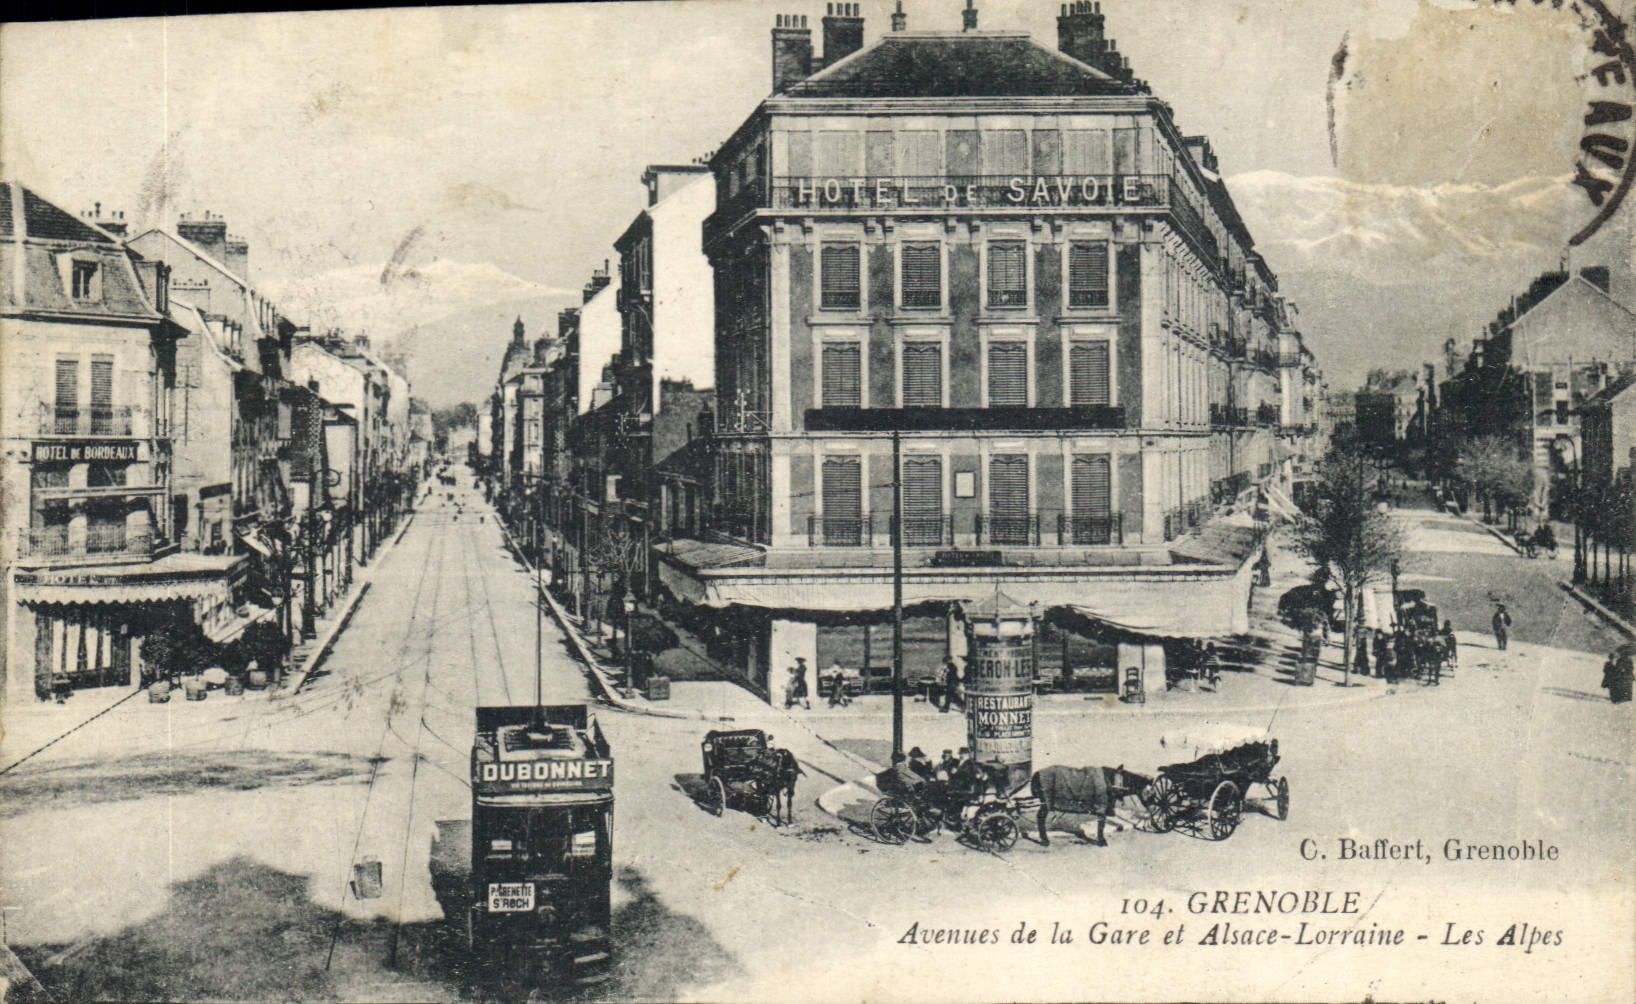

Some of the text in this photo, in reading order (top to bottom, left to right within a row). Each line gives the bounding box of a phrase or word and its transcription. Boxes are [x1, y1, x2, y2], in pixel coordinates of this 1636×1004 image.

[798, 175, 1142, 203] HOTEL DE SAVOIE
[36, 446, 69, 460] HOTEL
[83, 445, 136, 460] BORDEAUX
[483, 760, 611, 781] DUBONNET
